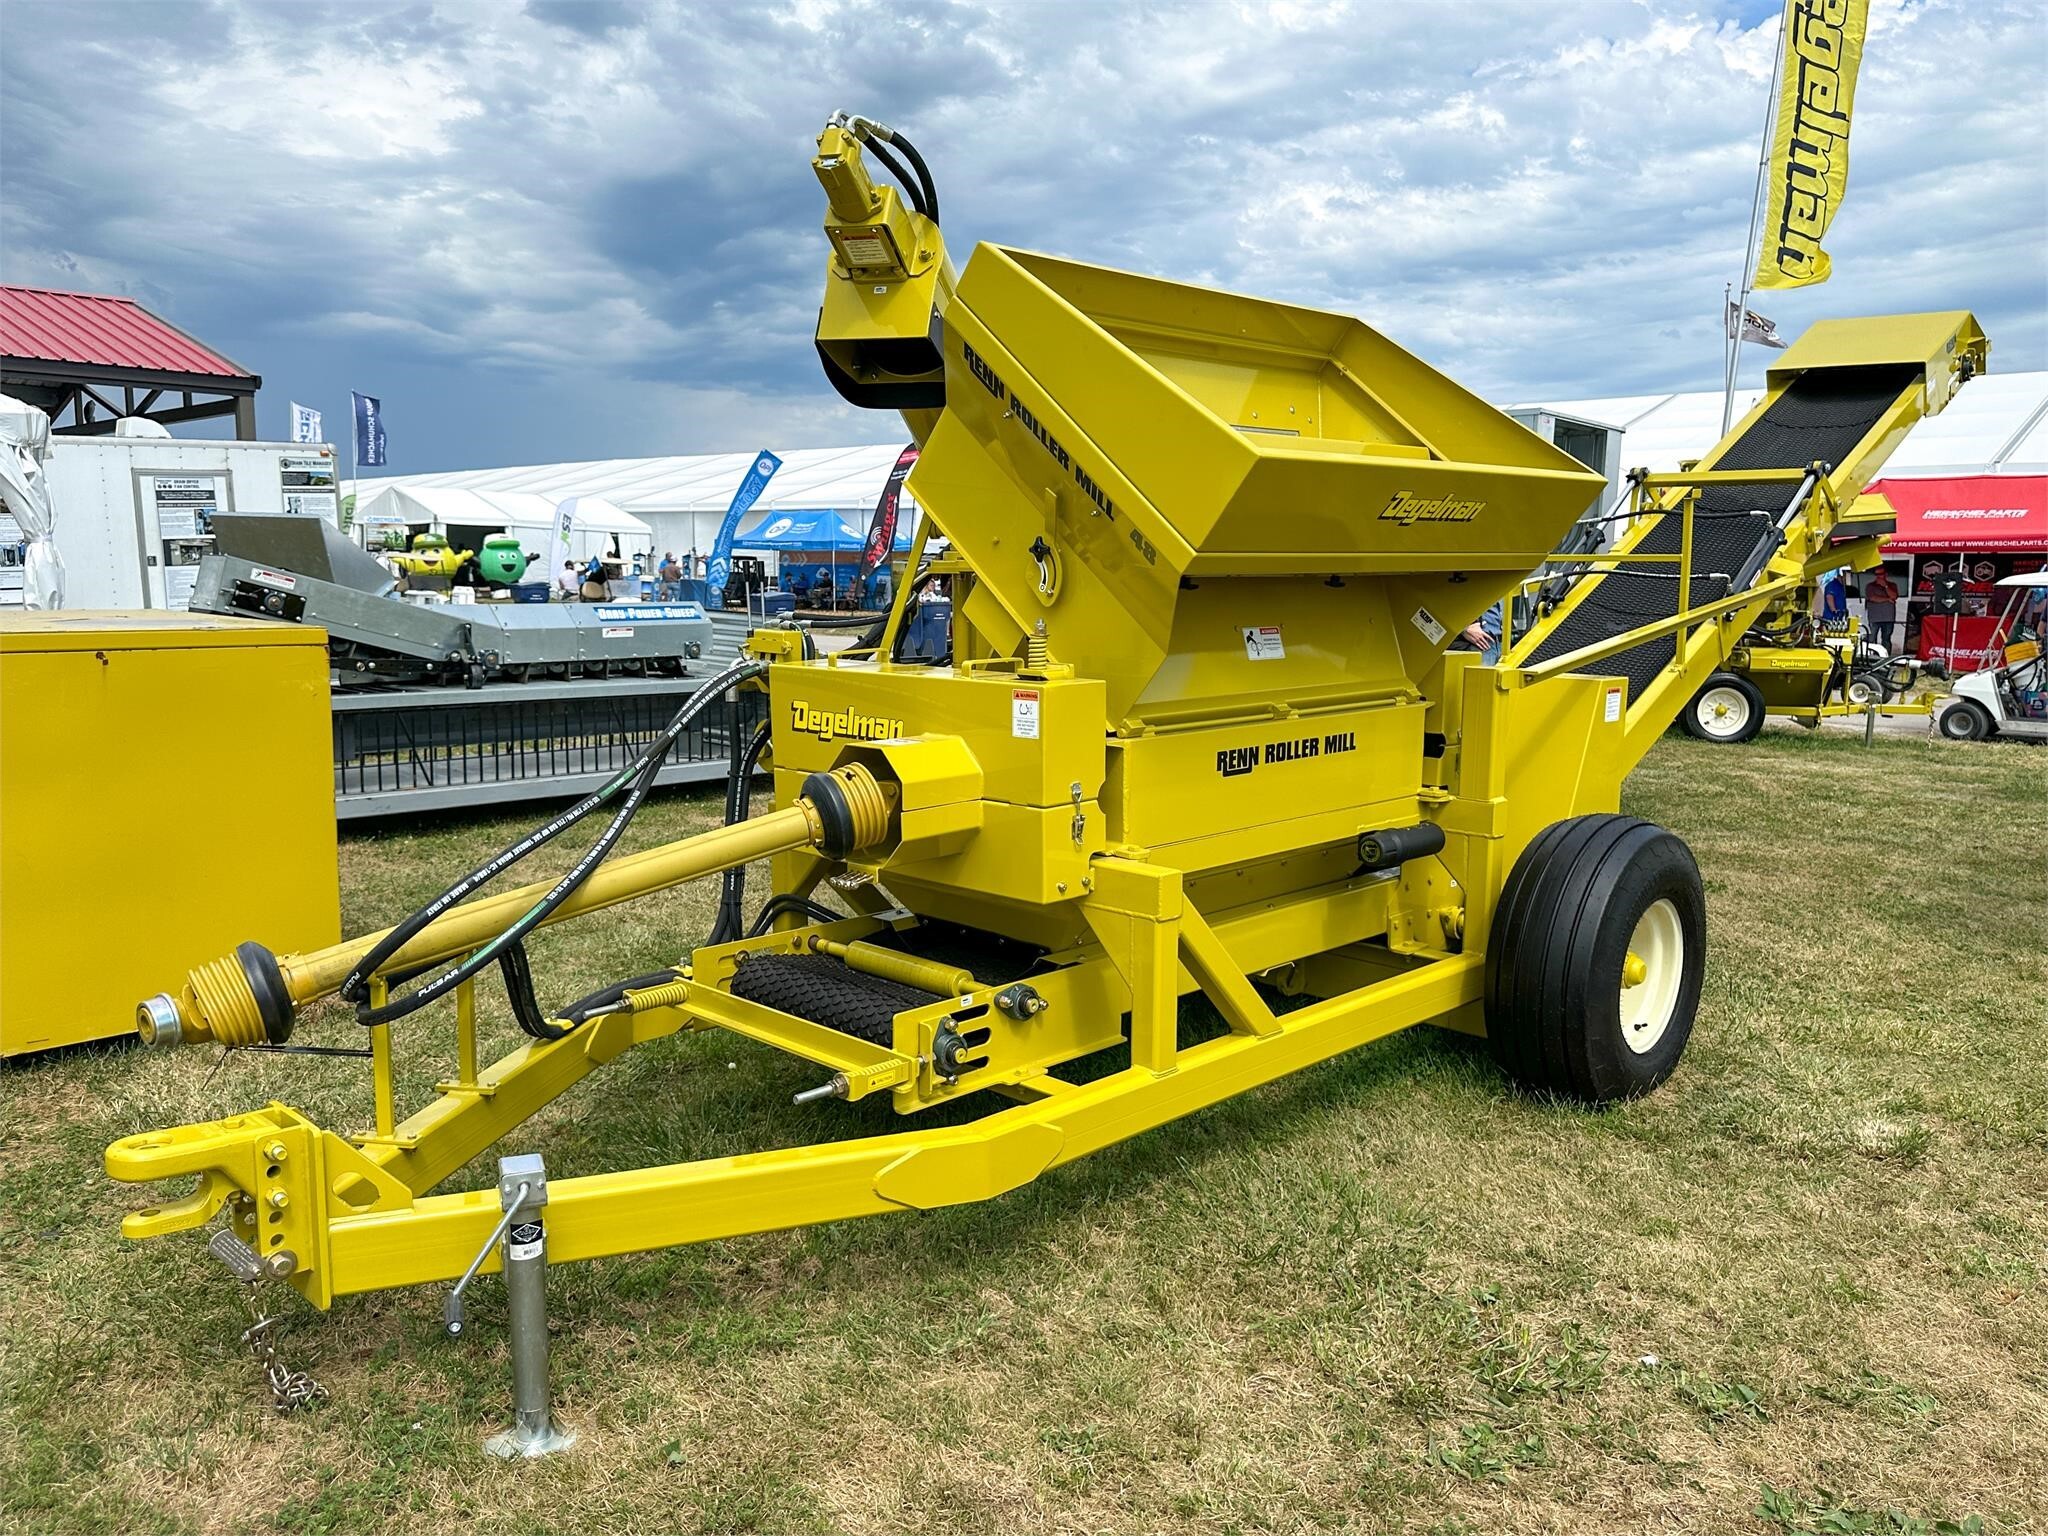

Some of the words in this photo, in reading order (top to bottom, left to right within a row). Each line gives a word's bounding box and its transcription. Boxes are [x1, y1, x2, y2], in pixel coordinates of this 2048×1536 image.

[963, 341, 1005, 400] RENN
[1010, 392, 1070, 472] ROLLER
[1074, 464, 1115, 522] MILL
[1129, 528, 1157, 566] 48
[1377, 490, 1487, 526] Degelman
[791, 699, 905, 742] Degelman
[1216, 746, 1260, 777] RENN
[1265, 737, 1319, 764] ROLLER
[1324, 732, 1356, 755] MILL
[439, 893, 452, 905] IN
[448, 880, 470, 899] MADE
[424, 899, 443, 917] ITALY
[418, 969, 459, 997] PULSAR
